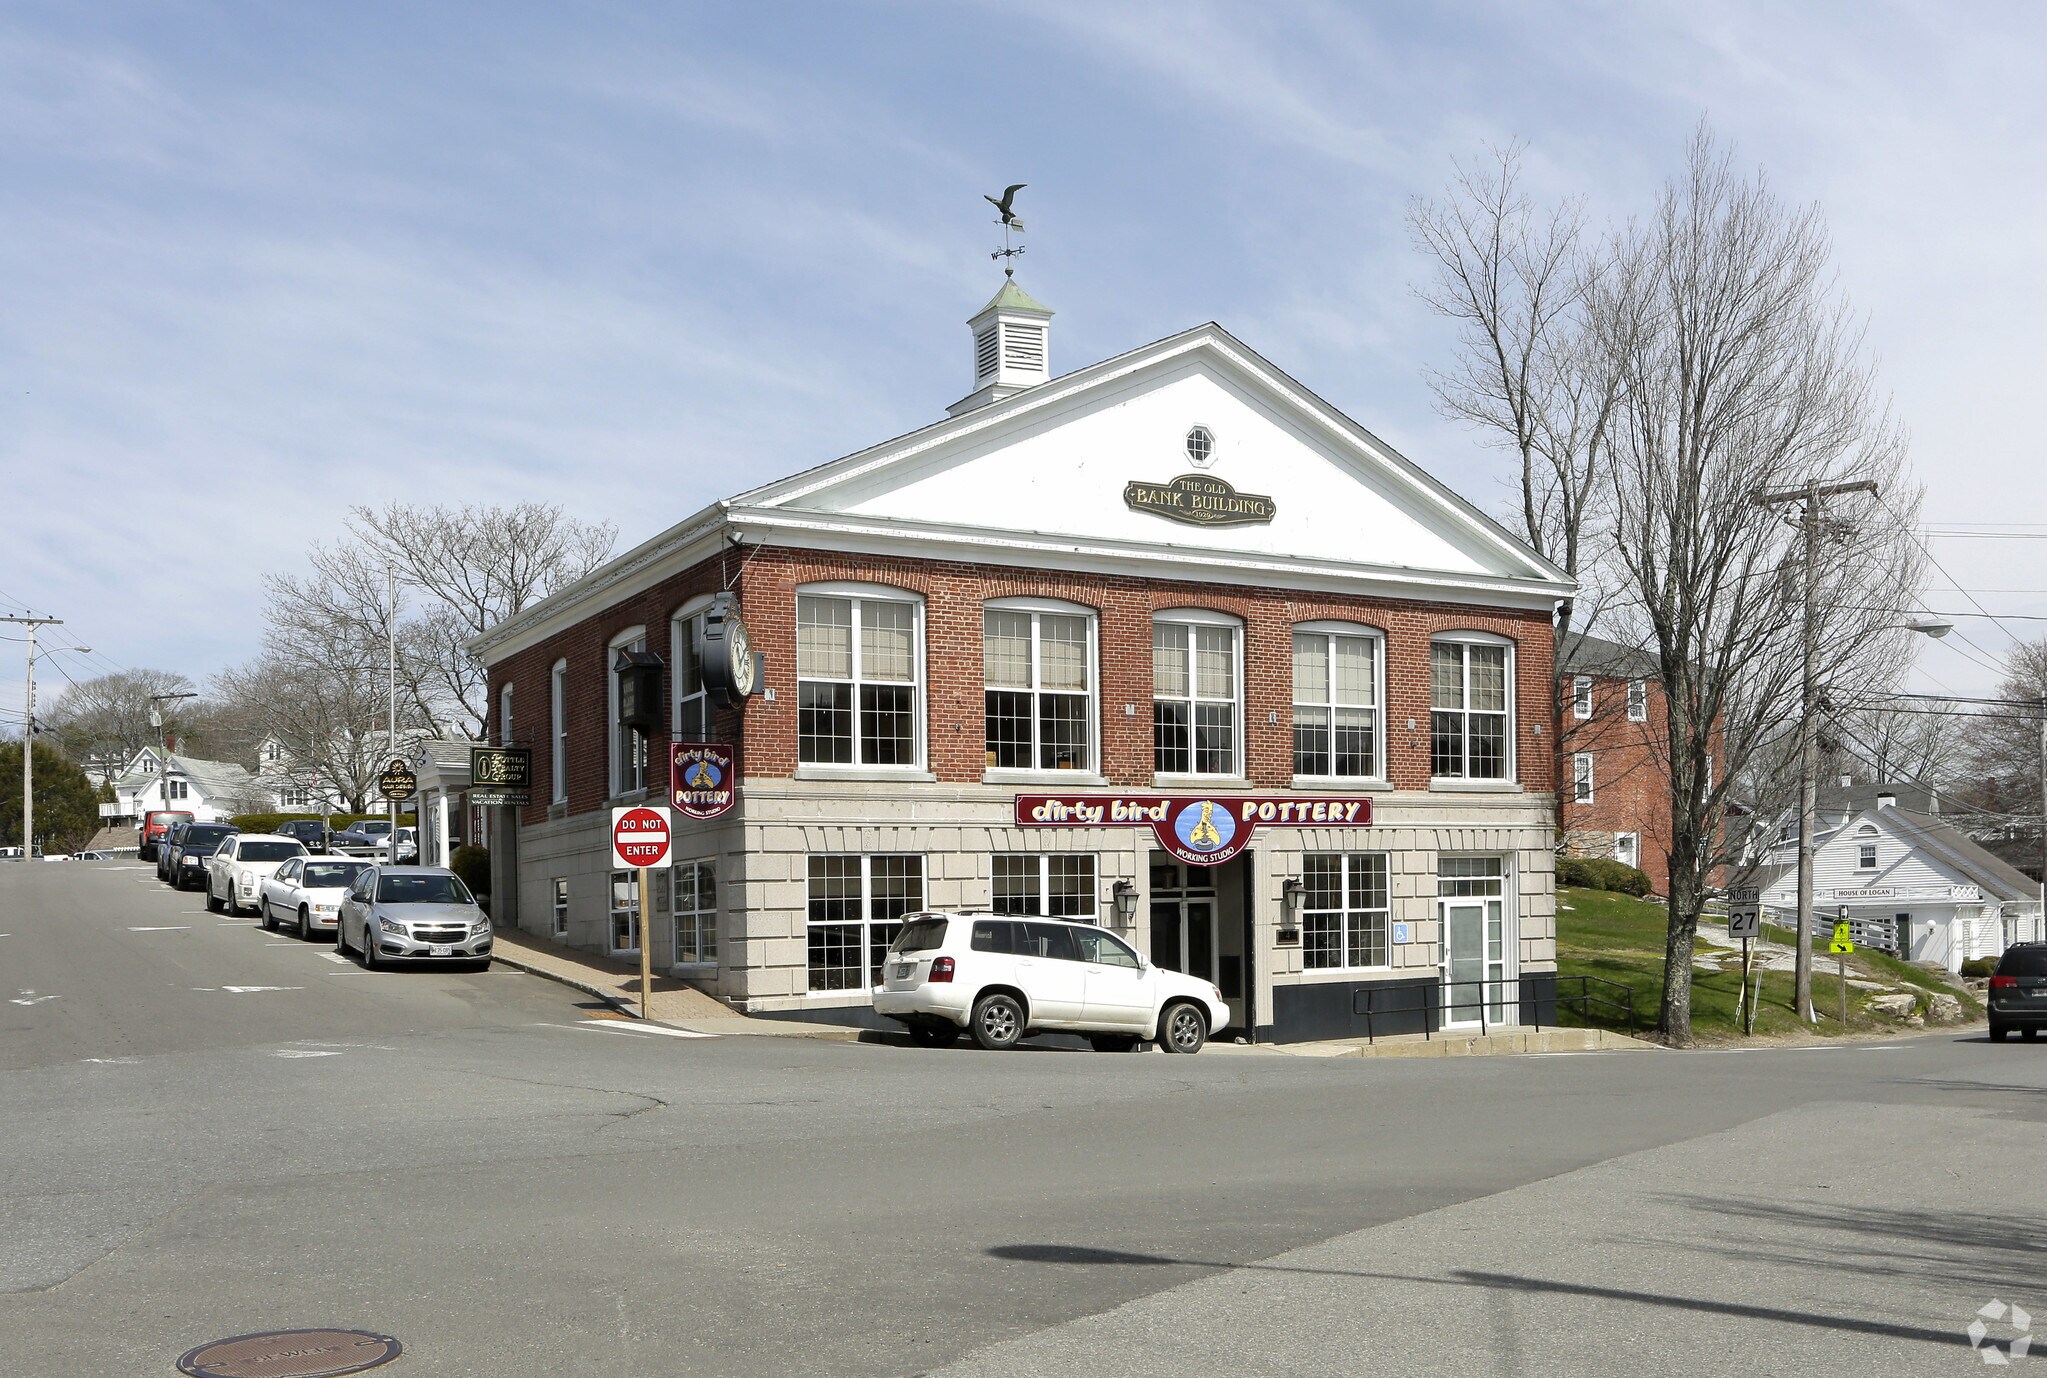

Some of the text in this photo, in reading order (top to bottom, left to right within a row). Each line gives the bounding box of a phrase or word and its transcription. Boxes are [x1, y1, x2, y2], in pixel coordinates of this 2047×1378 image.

[1180, 480, 1226, 495] THE OLD
[1136, 488, 1266, 515] BANK BUILDING
[675, 748, 731, 767] dirty bird
[491, 761, 525, 772] REALTY
[492, 771, 522, 781] GROUP
[676, 790, 731, 805] POTTERY
[685, 806, 721, 816] WORKING STUDIO
[1031, 800, 1361, 824] dirty bird POTTERY
[622, 820, 662, 829] DO NOT
[626, 846, 659, 856] ENTER
[1176, 846, 1235, 863] WORKING STUDIO
[1730, 890, 1758, 900] NORTH
[1732, 912, 1756, 930] 27
